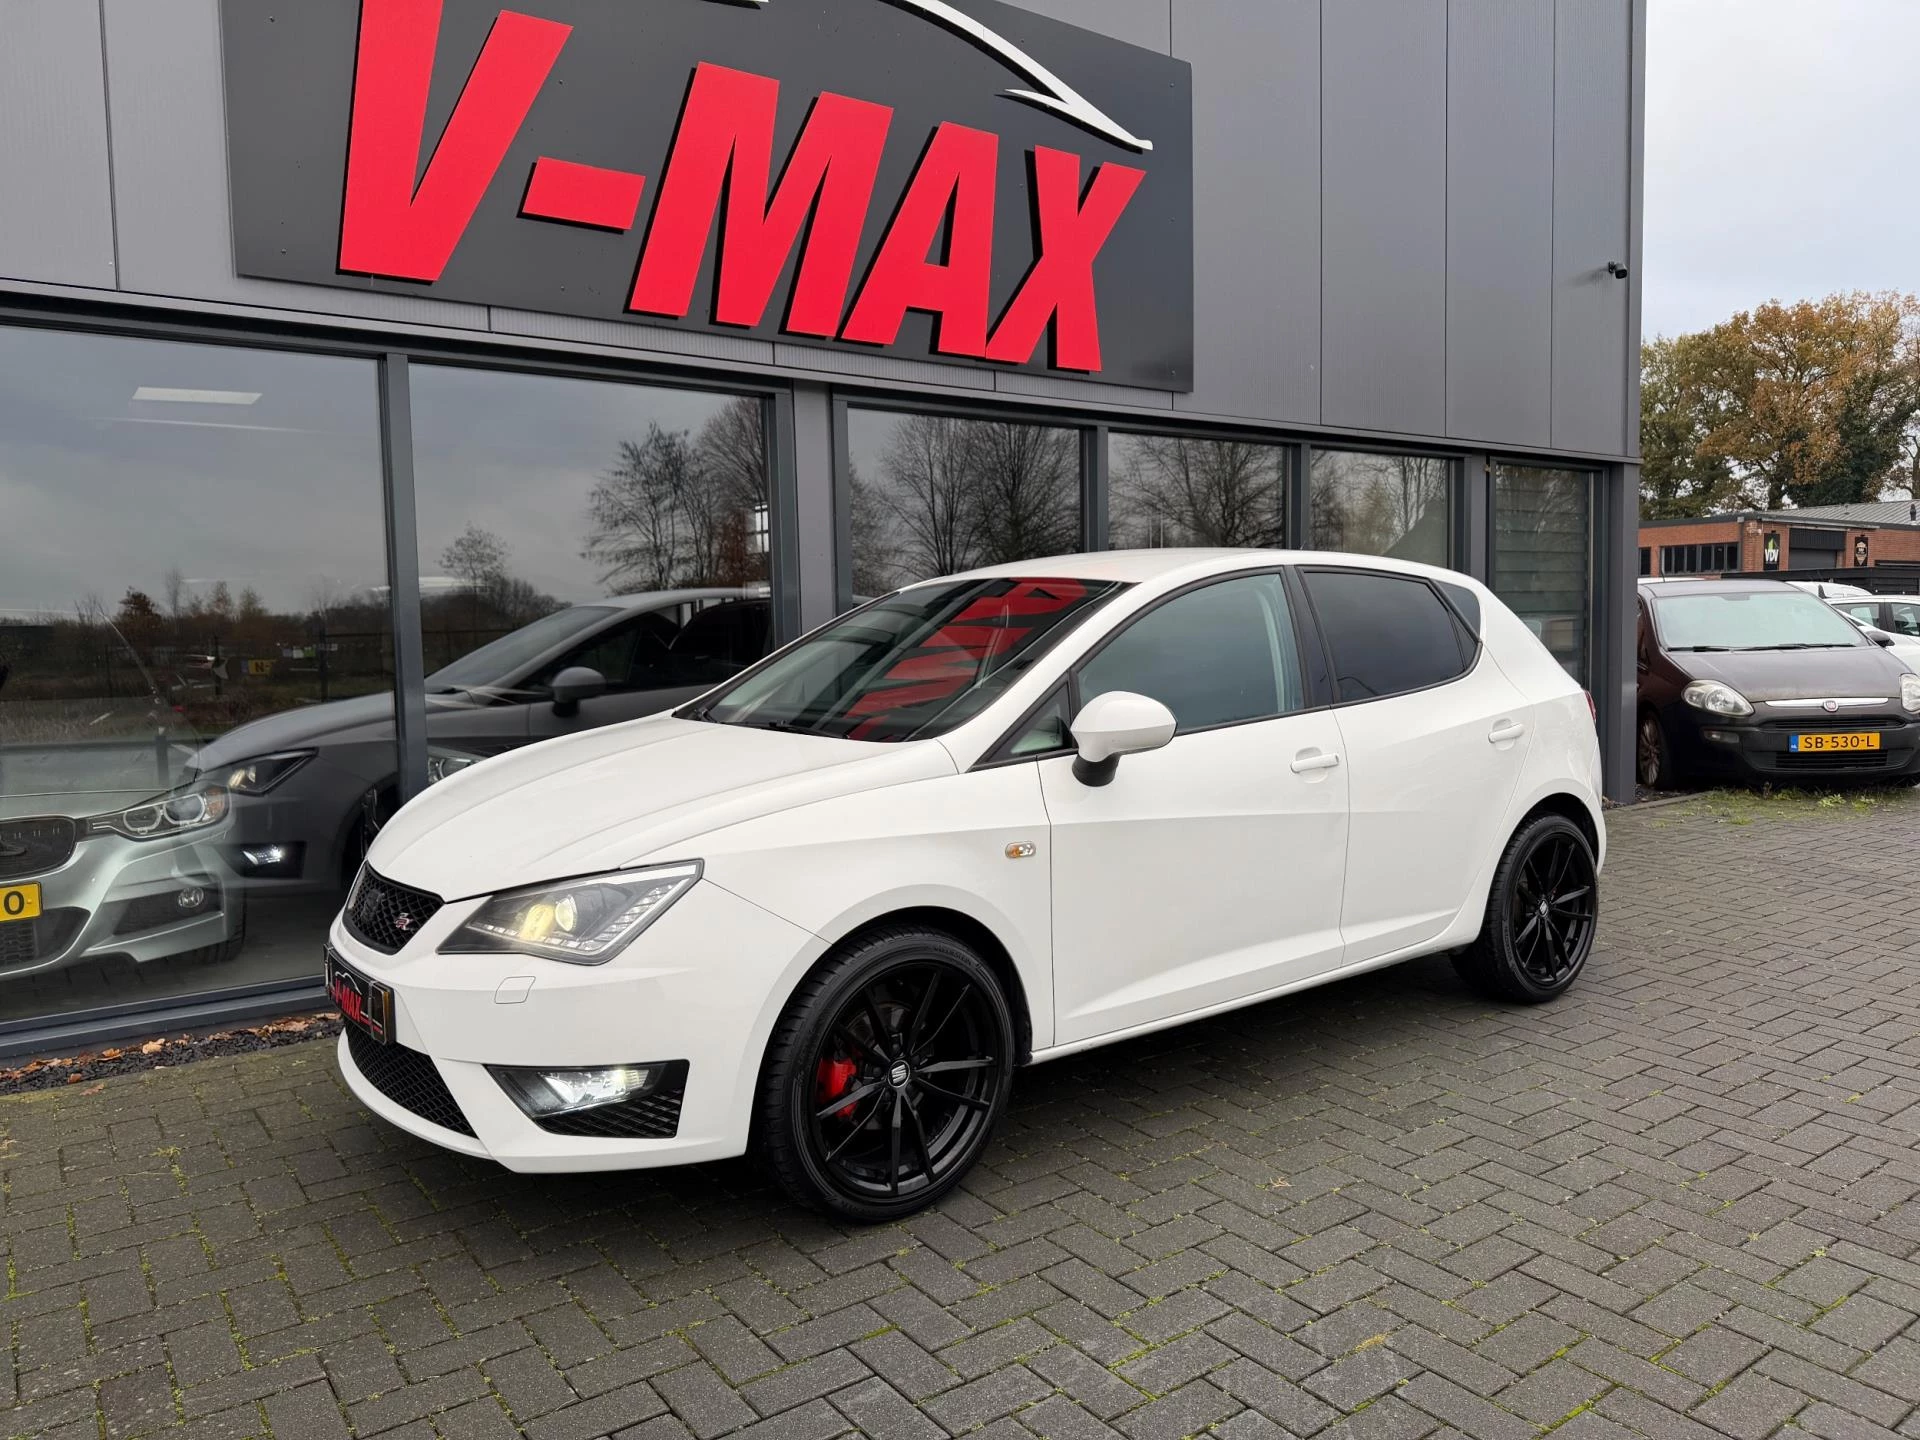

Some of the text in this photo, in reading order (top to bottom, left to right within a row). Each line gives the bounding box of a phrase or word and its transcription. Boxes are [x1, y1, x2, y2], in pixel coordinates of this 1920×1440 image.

[338, 0, 1146, 372] V-MAX
[1764, 548, 1780, 562] VDV
[1804, 735, 1874, 749] SB-530-L
